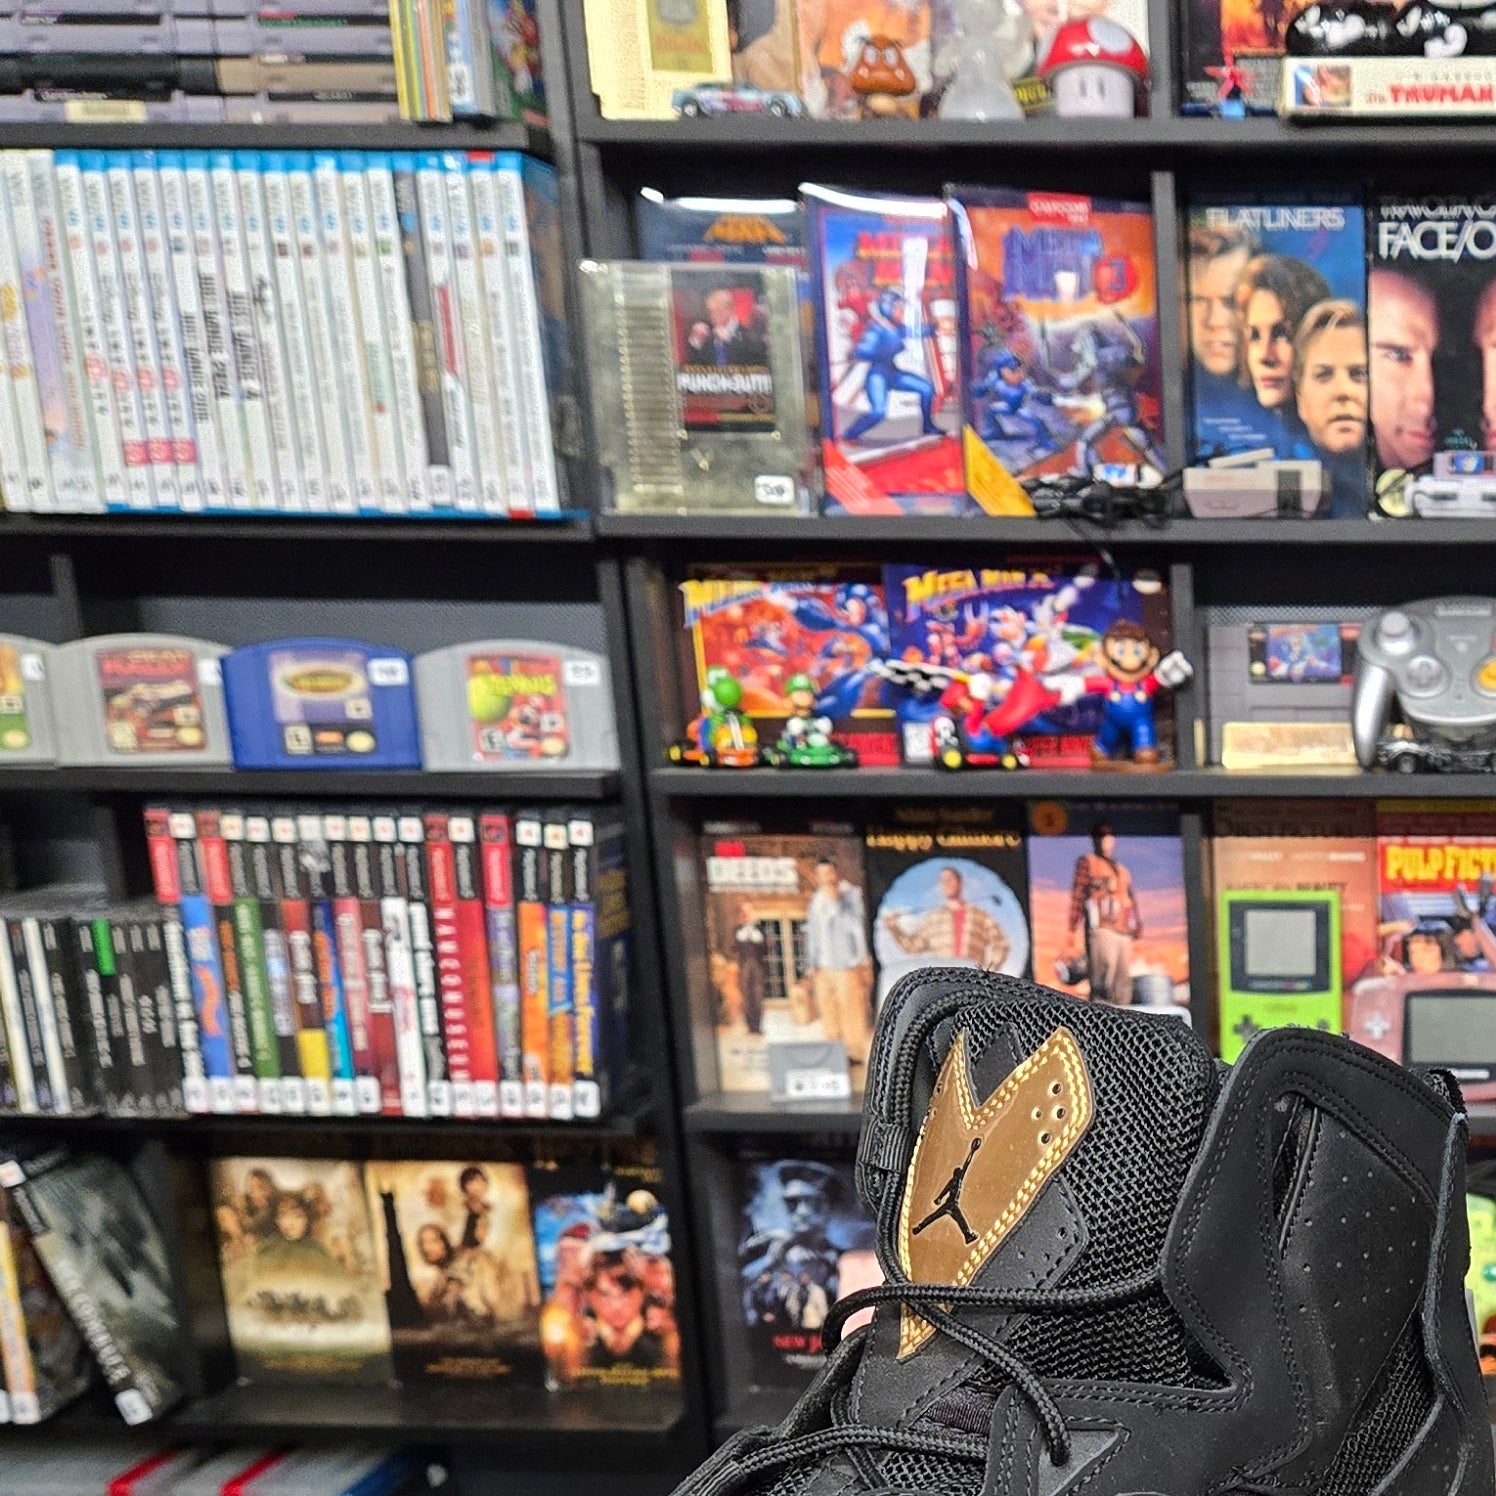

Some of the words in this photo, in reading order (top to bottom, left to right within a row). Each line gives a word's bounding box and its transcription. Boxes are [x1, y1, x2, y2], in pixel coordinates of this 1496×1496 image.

[1390, 84, 1494, 104] TRUMAN
[1205, 206, 1345, 232] FLATLINERS
[1385, 846, 1443, 881] PULP
